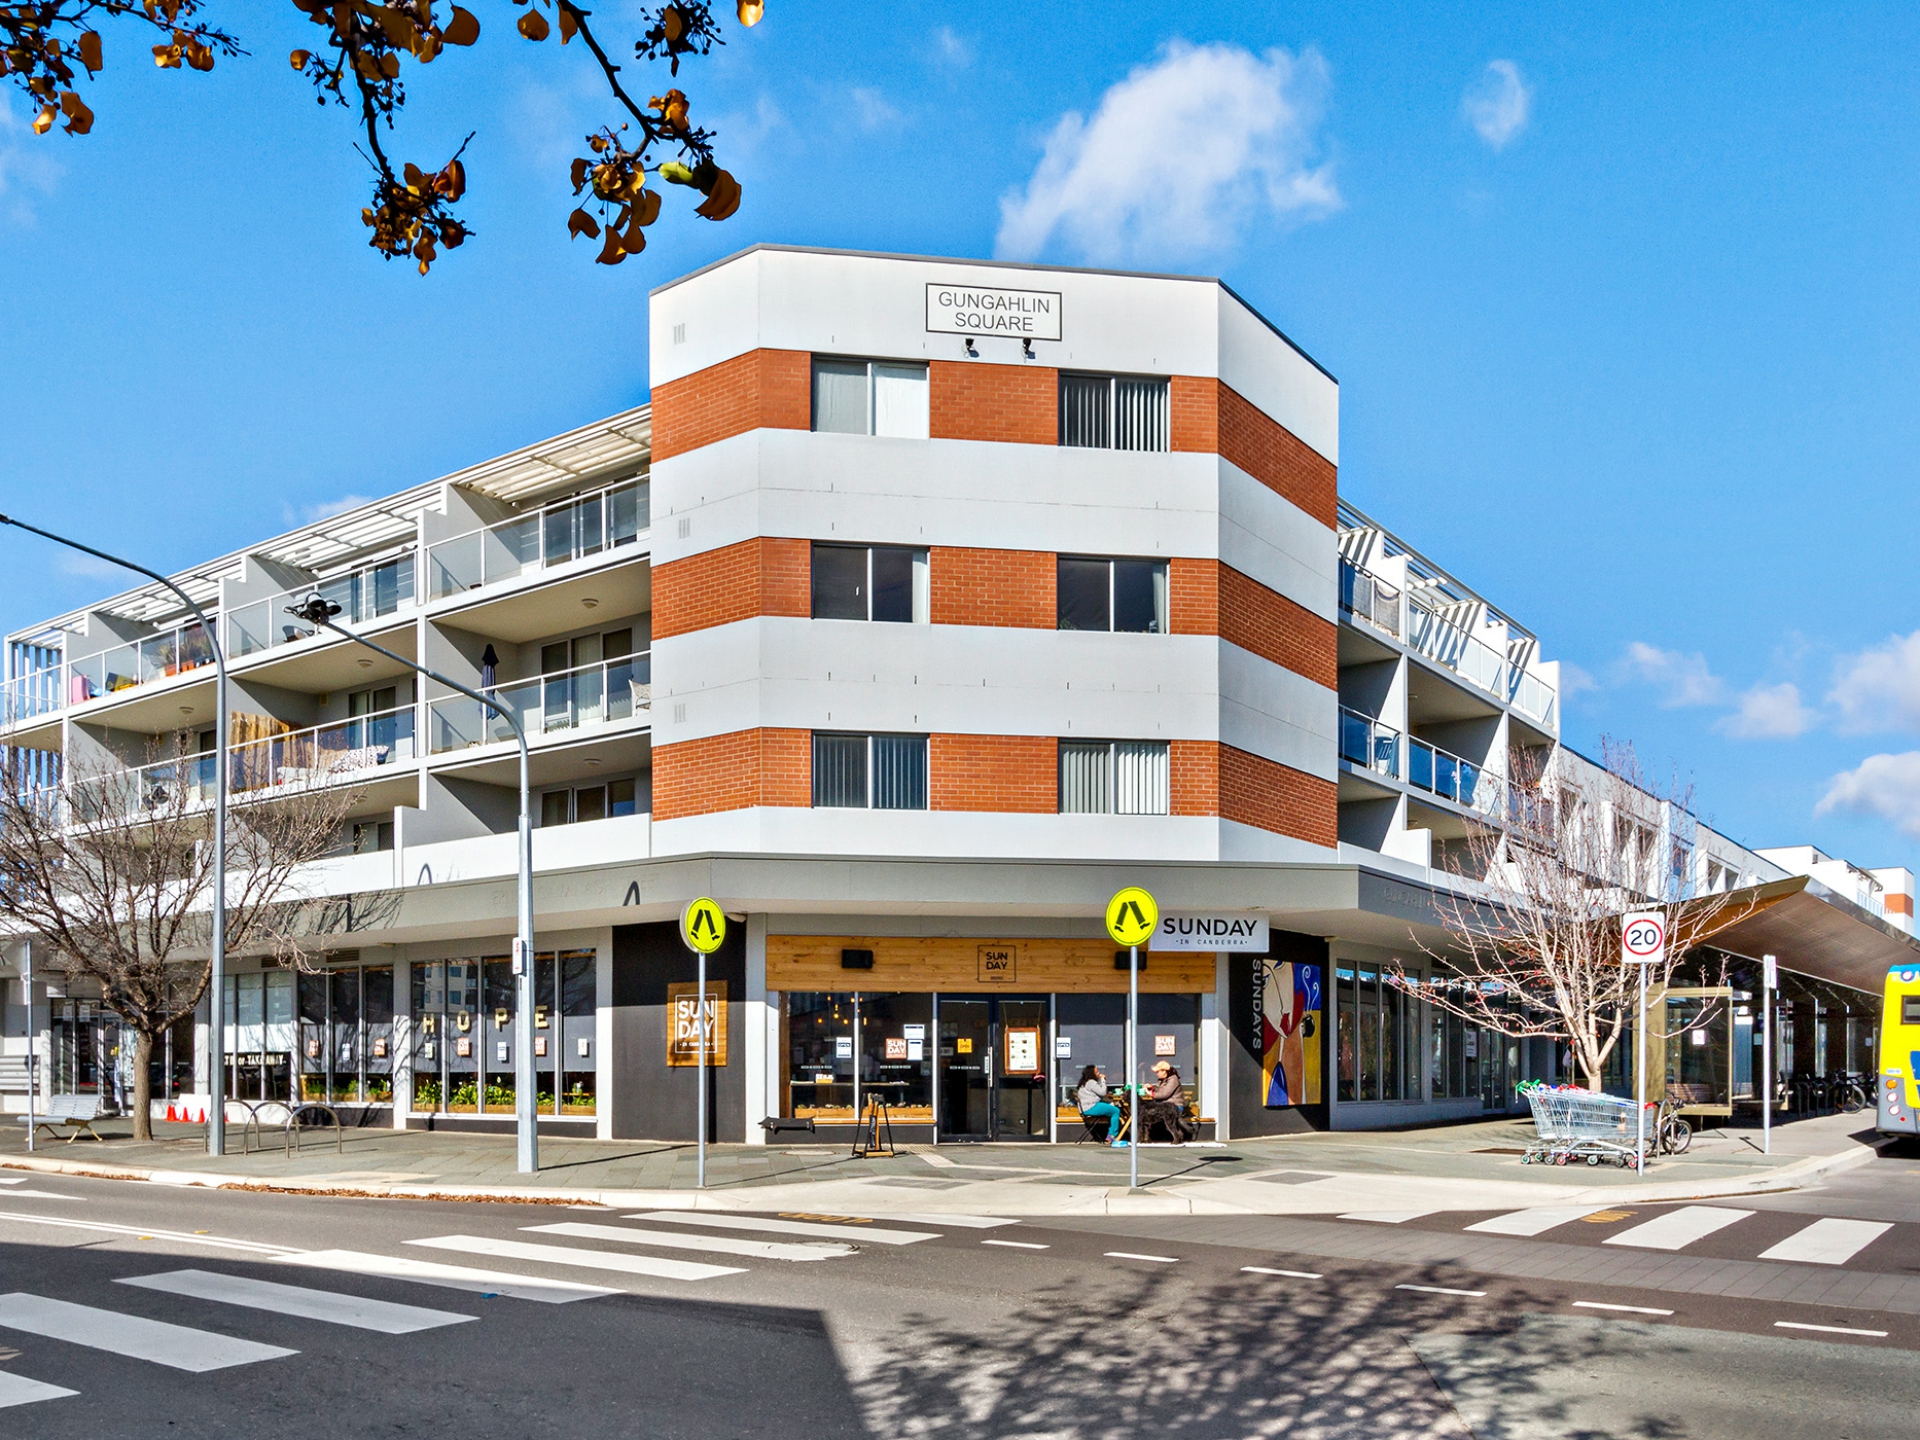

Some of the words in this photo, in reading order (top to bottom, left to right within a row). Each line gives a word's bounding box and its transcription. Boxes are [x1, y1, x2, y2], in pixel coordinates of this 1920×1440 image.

[938, 291, 1050, 314] GUNGAHLIN
[955, 312, 1034, 332] SQUARE
[1163, 917, 1258, 937] SUNDAY
[1197, 938, 1244, 946] CANBERRA
[1630, 929, 1657, 946] 20
[985, 951, 1008, 961] SUN
[986, 961, 1008, 970] DAY
[678, 1000, 714, 1019] SUN
[1252, 958, 1262, 1050] SUNDAYS
[678, 1019, 714, 1039] DAY
[887, 1039, 906, 1047] SUN
[887, 1046, 905, 1054] DAY
